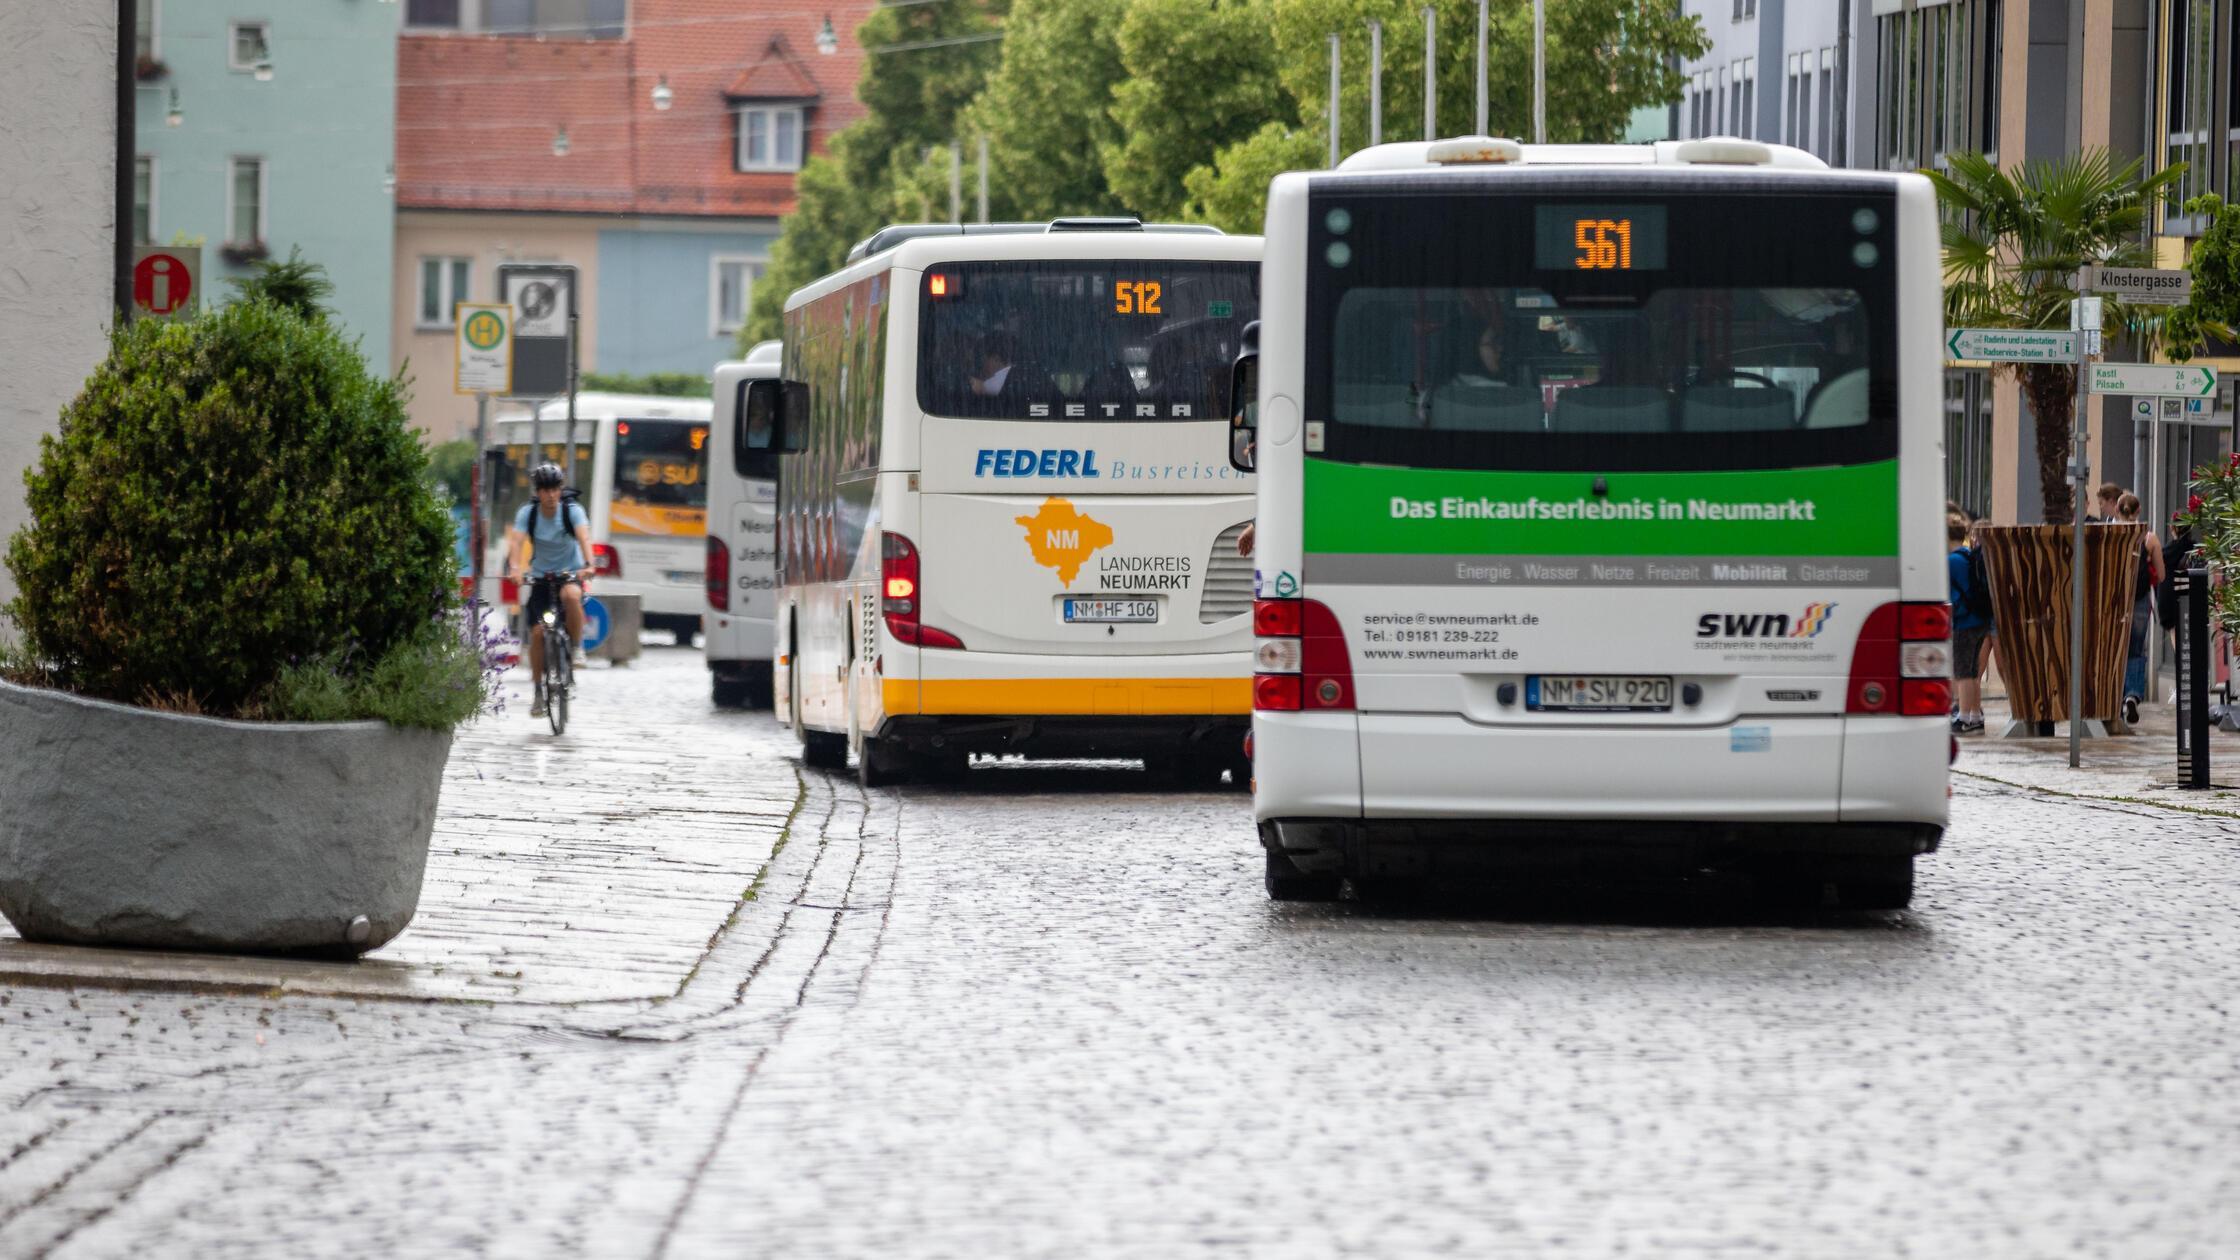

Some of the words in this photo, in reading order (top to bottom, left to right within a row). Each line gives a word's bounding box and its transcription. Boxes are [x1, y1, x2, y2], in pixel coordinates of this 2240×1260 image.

[1574, 219, 1632, 269] 561
[2101, 271, 2182, 290] Klostergasse
[1115, 280, 1161, 314] 512
[2021, 336, 2057, 345] Ladestation
[1984, 348, 2043, 357] Radservice-Station
[2096, 369, 2117, 378] Kastl
[2175, 371, 2184, 380] 26
[2096, 379, 2124, 389] Pilsach
[1029, 404, 1192, 417] SETRA
[974, 449, 1100, 479] FEDERL
[1390, 497, 1437, 518] Das
[1441, 496, 1655, 520] Einkaufserlebnis
[1658, 498, 1683, 520] in
[1688, 498, 1816, 520] Neumarkt
[1046, 529, 1079, 549] NM
[1100, 557, 1191, 571] LANDKREIS
[1456, 562, 1512, 583] Energie
[1524, 563, 1579, 580] Wasser
[1591, 563, 1634, 580] Netze
[1648, 563, 1700, 580] Freizeit
[1713, 564, 1788, 581] Mobilität
[1800, 564, 1870, 581] Glasfaser
[1100, 575, 1191, 589] NEUMARKT
[1127, 602, 1155, 617] 106
[1364, 613, 1540, 626] service@swneumarkt.de
[1697, 614, 1790, 638] swn
[1364, 630, 1392, 642] Tel.:
[1396, 630, 1438, 642] 09181
[1443, 630, 1499, 643] 239-222
[1694, 641, 1756, 650] stadtwerke
[1760, 641, 1814, 650] neumarkt
[1364, 649, 1519, 660] www.swneumarkt.de
[1626, 681, 1668, 702] 920
